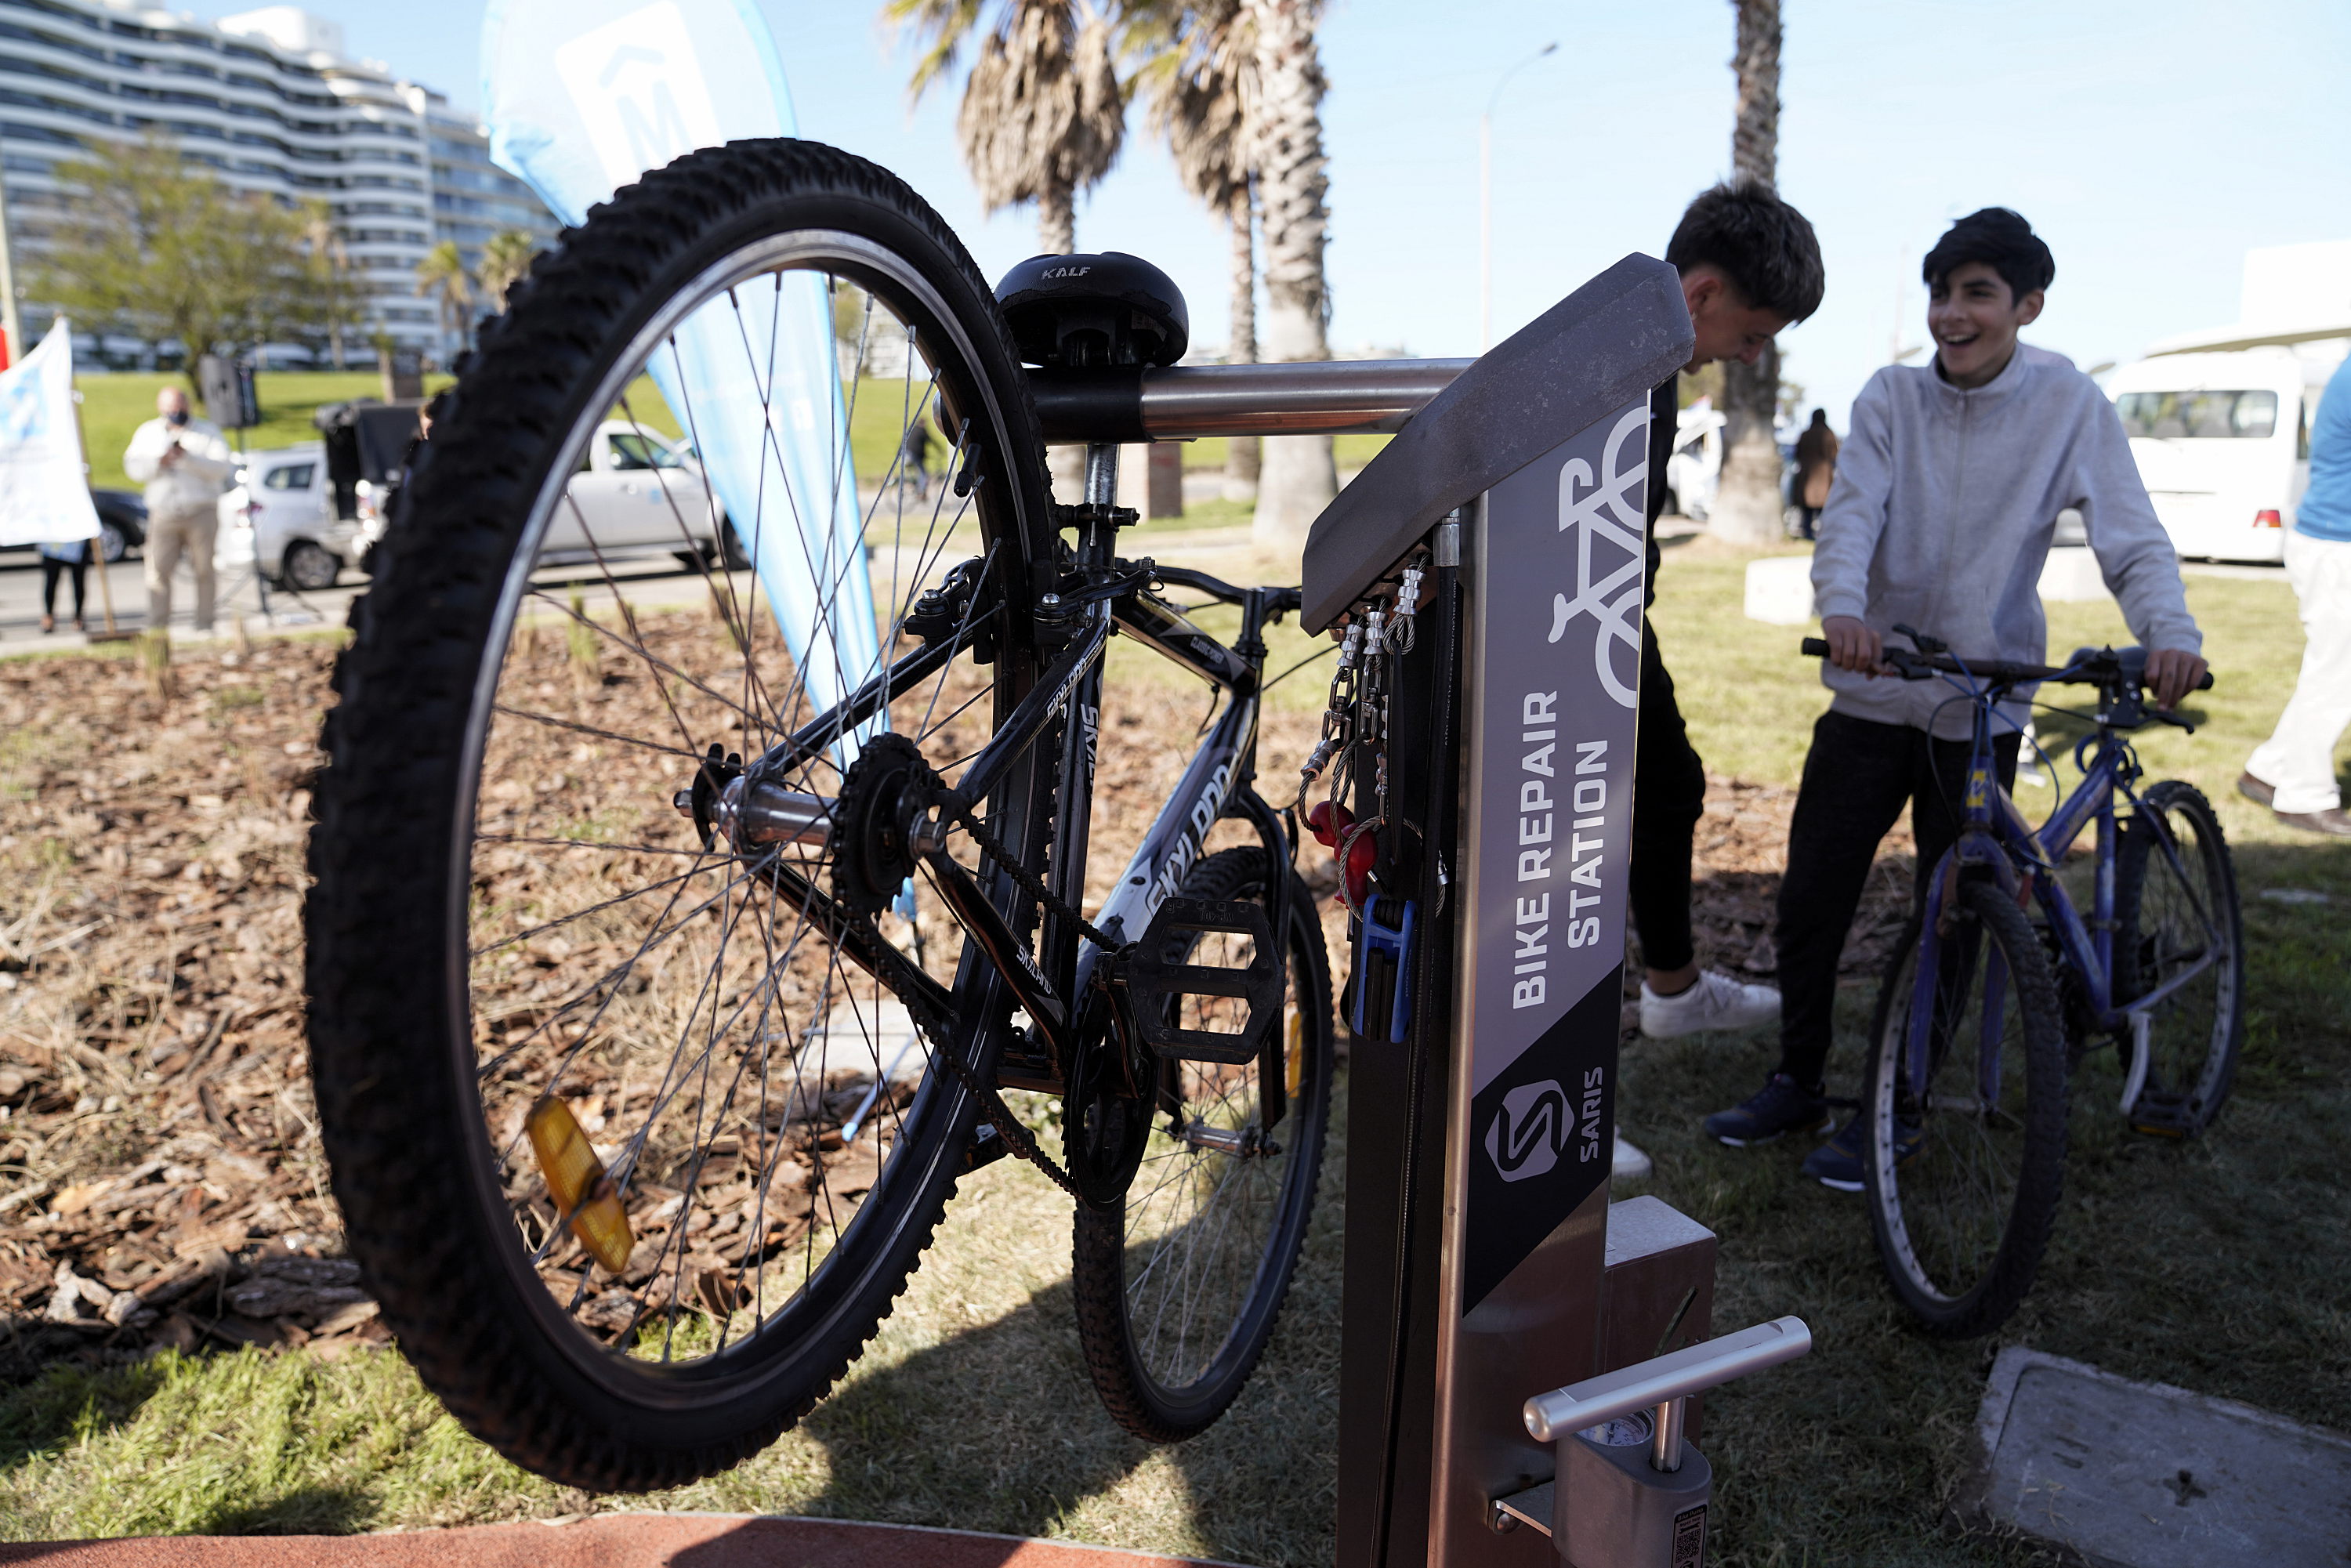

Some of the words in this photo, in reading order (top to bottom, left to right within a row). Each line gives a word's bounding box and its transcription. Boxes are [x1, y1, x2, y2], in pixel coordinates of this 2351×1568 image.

[1518, 690, 1557, 882] REPAIR
[1567, 740, 1608, 948] STATION
[1016, 943, 1052, 994] SKYLAND
[1512, 893, 1549, 1009] BIKE
[1580, 1066, 1603, 1163] SARIS
